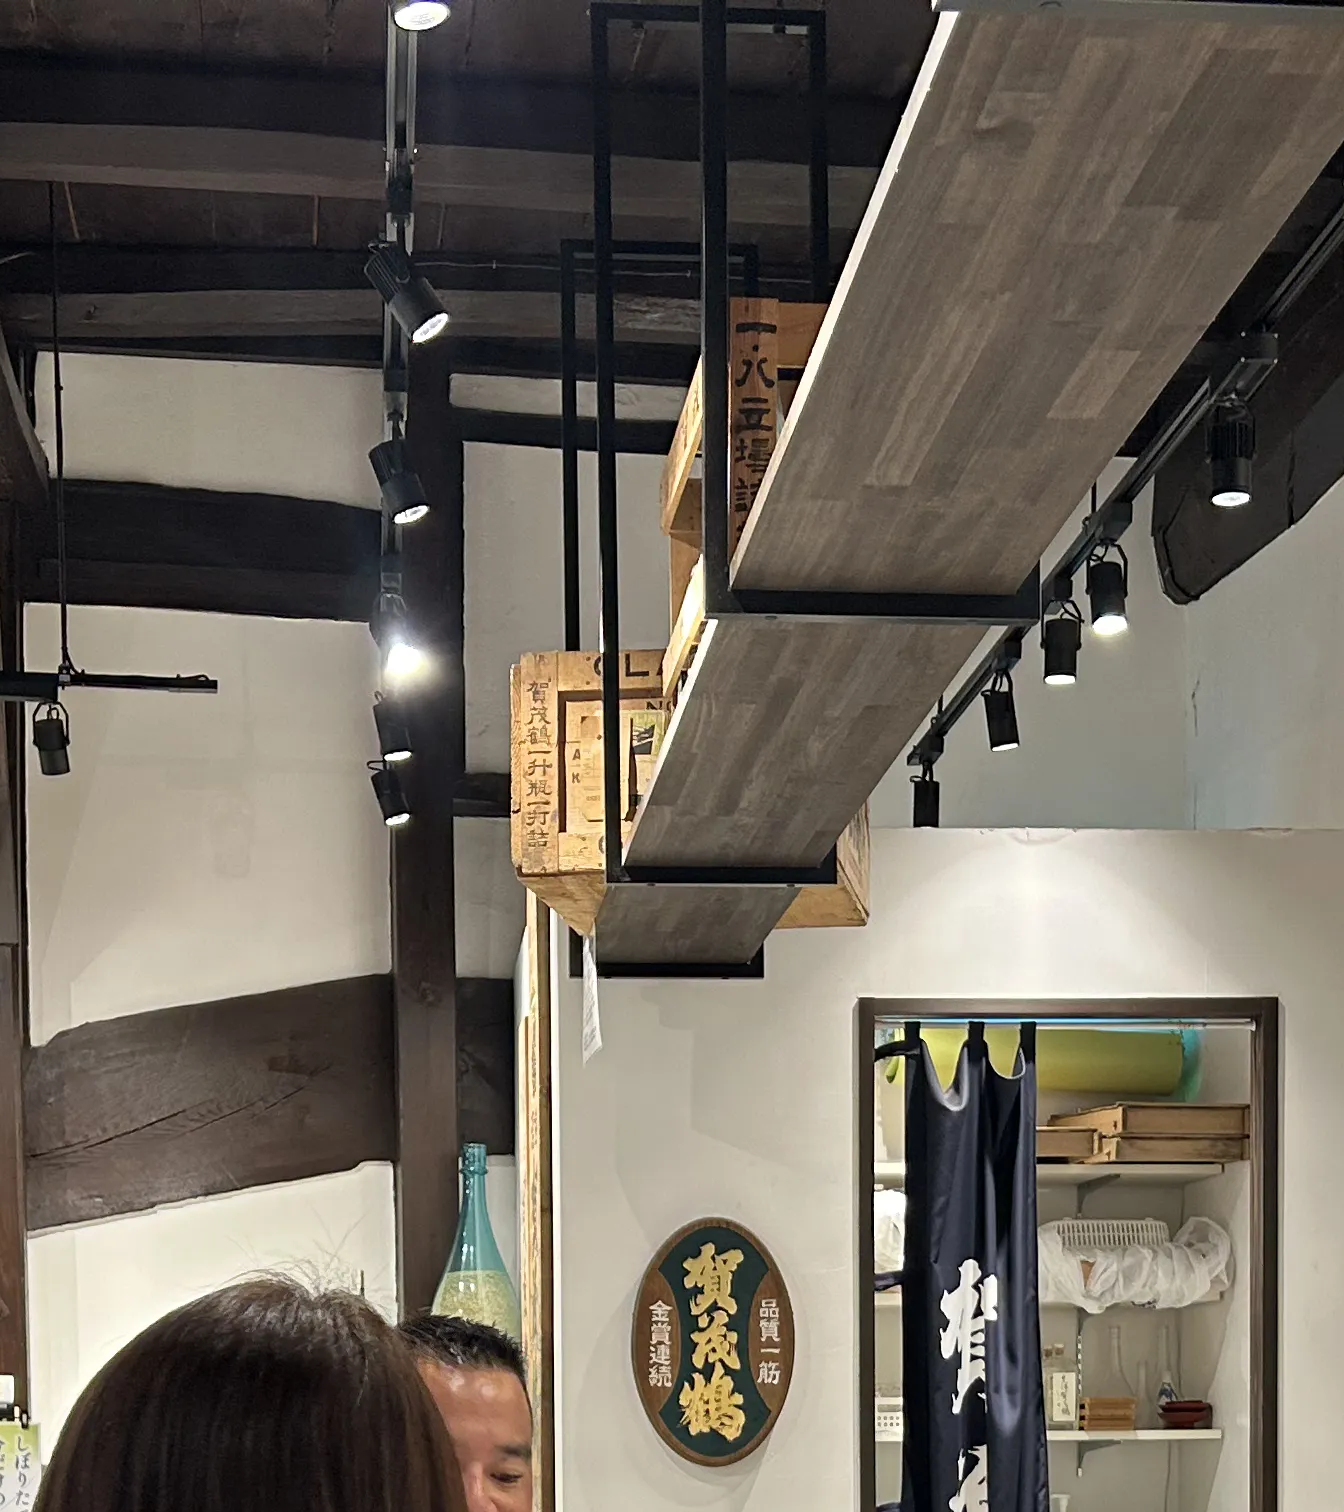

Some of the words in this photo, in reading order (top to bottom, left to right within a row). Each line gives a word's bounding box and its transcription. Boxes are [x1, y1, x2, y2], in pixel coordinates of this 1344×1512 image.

[526, 678, 553, 848] 賀茂鶴一升瓶一打詰
[648, 1300, 673, 1388] 金賞連続
[679, 1242, 746, 1442] 賀茂鶴
[757, 1299, 782, 1385] 品質一筋
